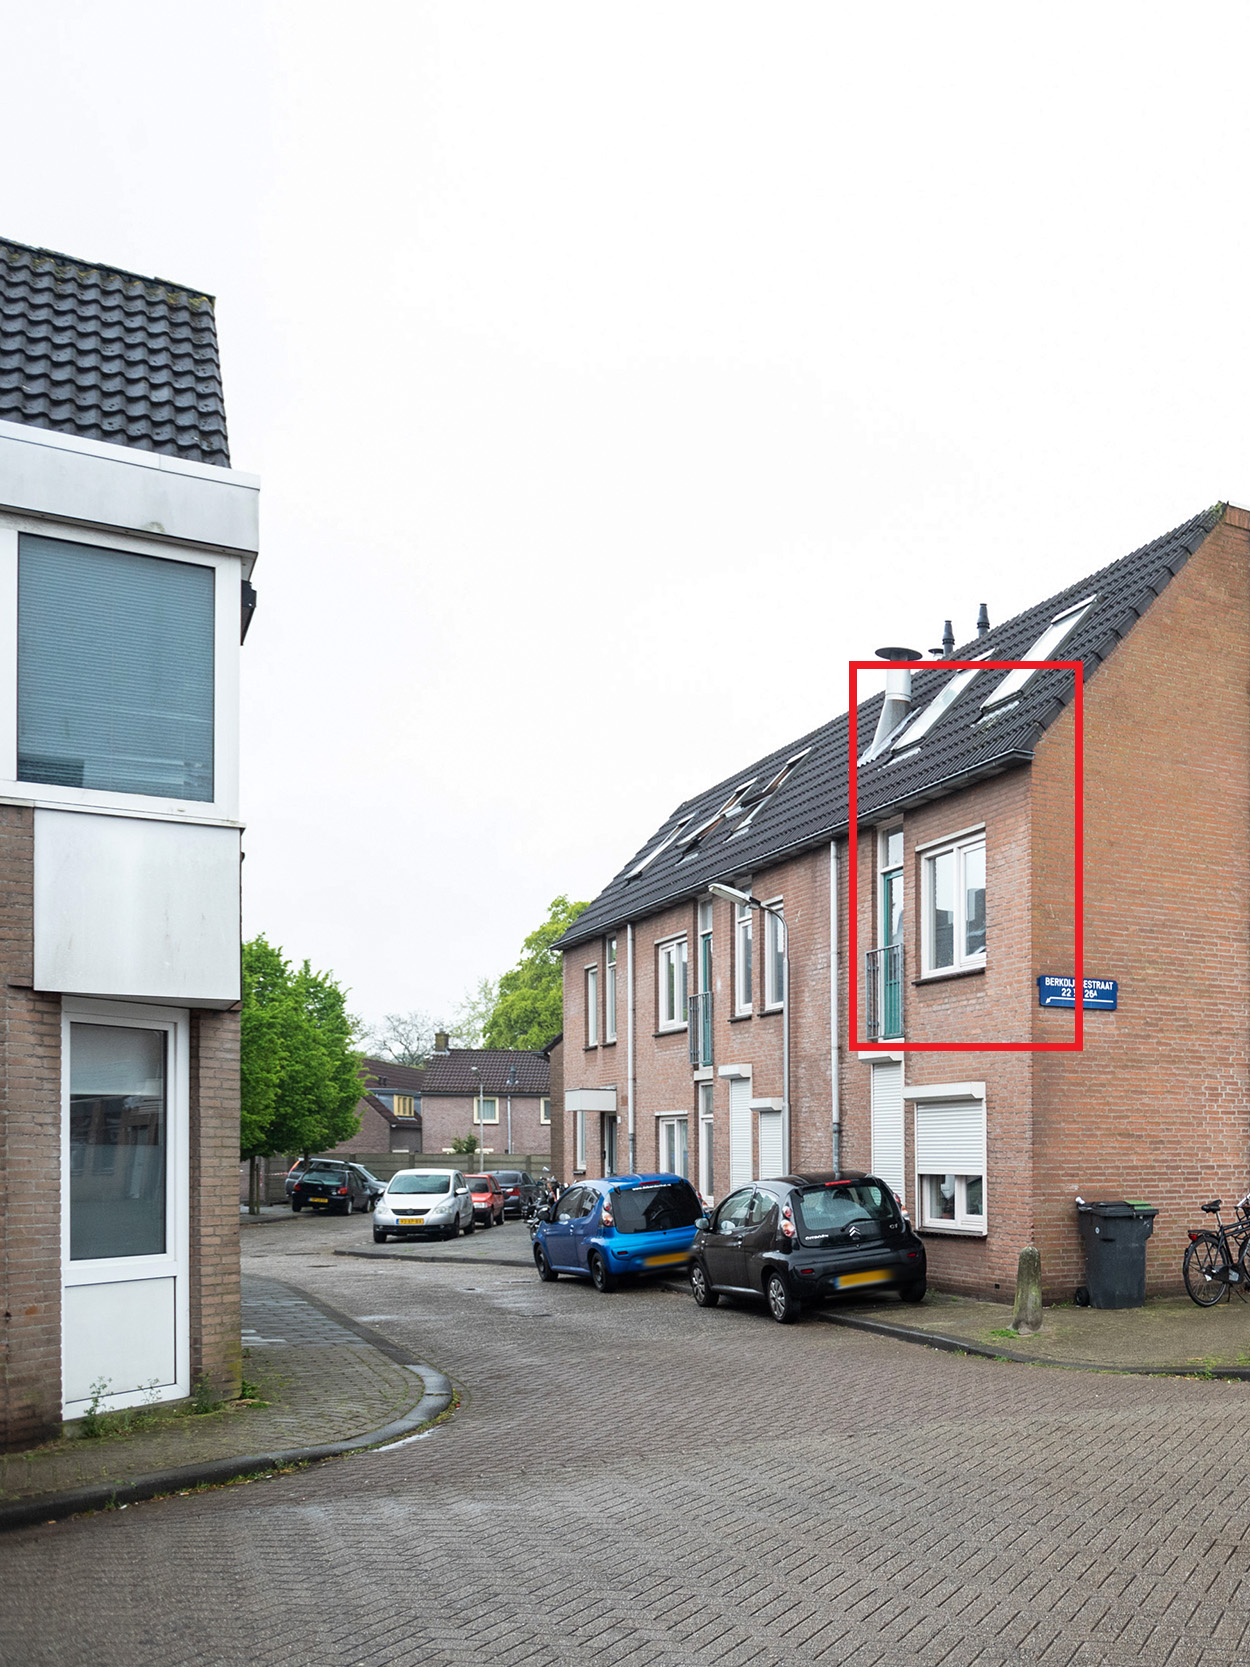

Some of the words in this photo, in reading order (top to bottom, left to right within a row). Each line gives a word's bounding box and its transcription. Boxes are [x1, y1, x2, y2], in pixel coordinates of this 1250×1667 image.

[1045, 977, 1114, 990] BERKDIJESTRAAT
[1061, 988, 1072, 997] 22
[1084, 989, 1098, 998] 26A
